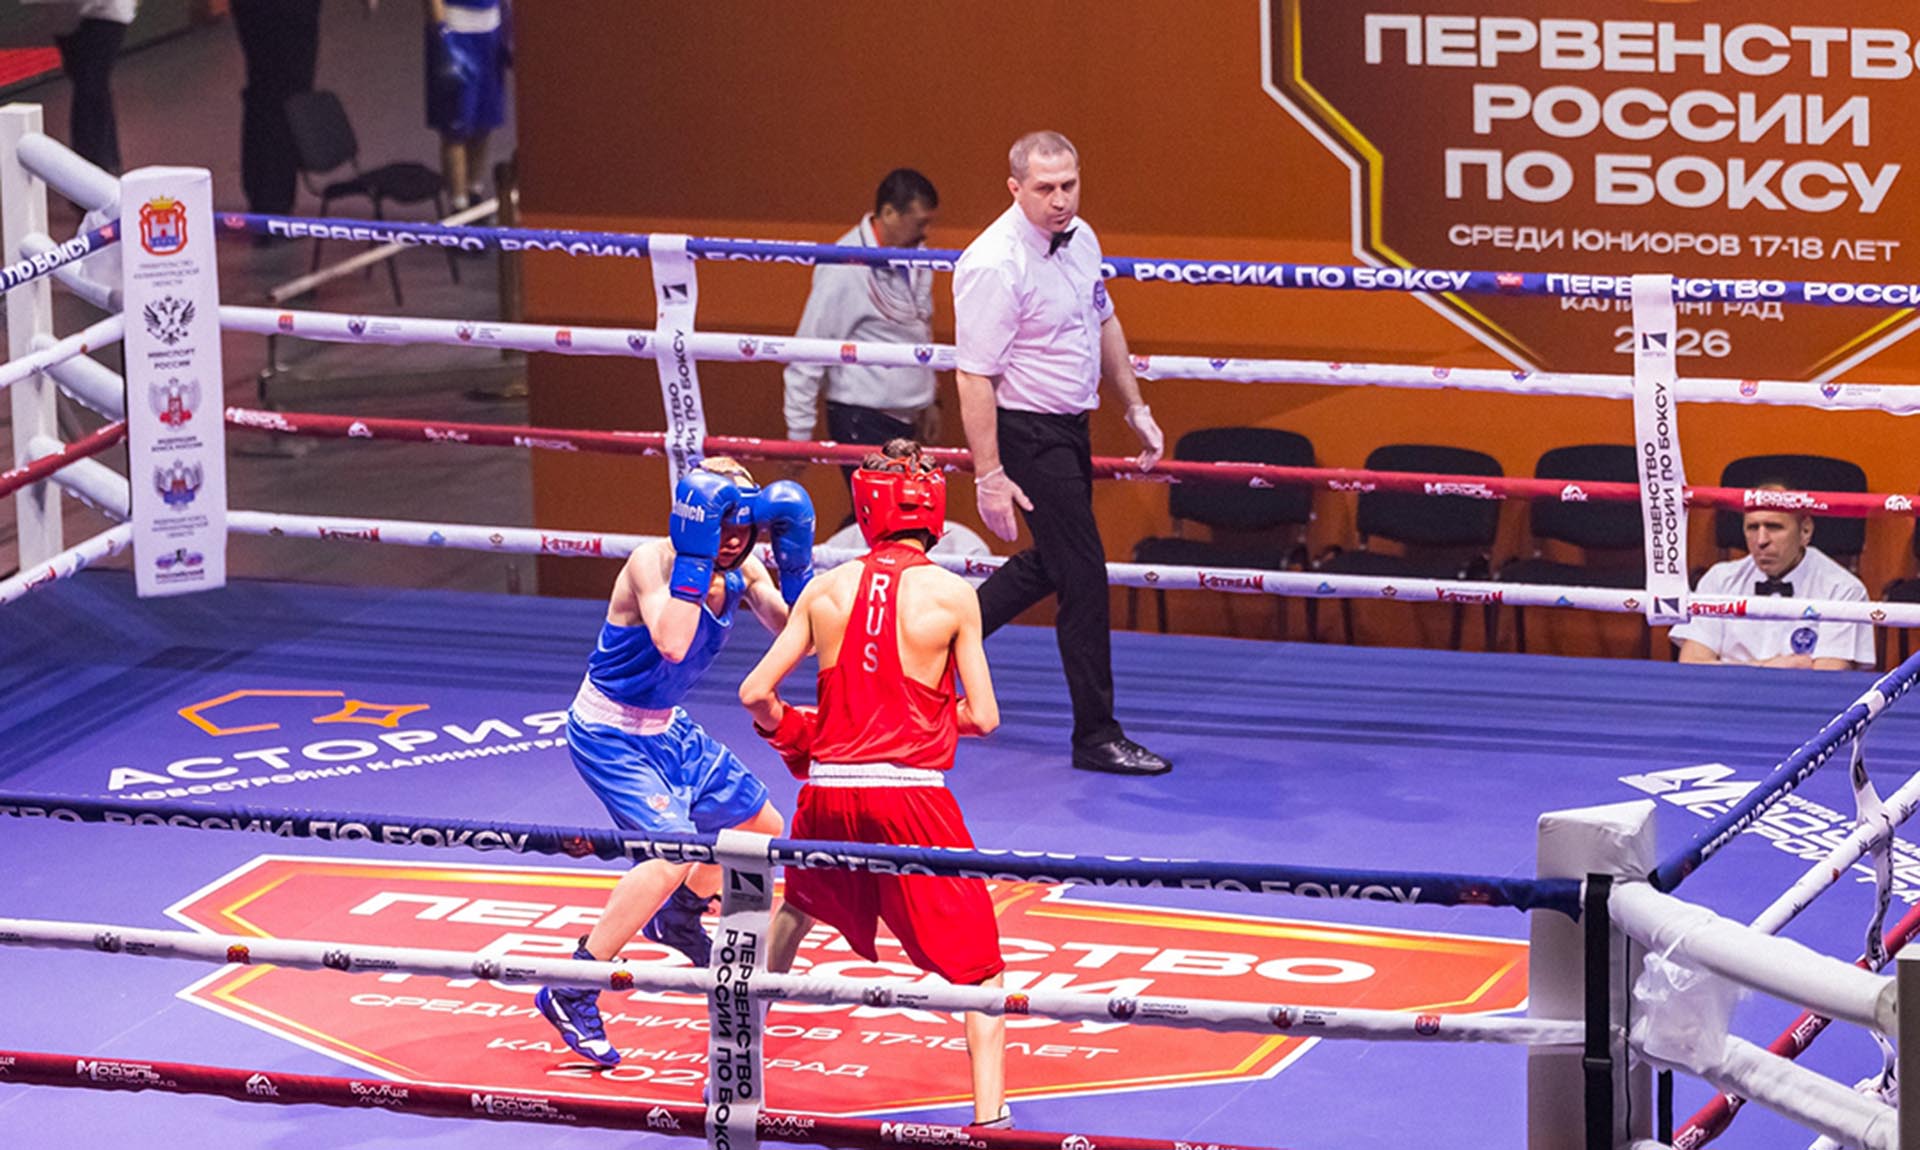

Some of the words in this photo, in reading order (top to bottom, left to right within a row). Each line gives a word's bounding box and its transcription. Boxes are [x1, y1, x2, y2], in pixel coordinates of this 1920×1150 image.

[1364, 14, 1920, 80] ПЕРВЕНСТВ
[1473, 84, 1870, 147] РОССИИ
[1445, 149, 1574, 202] ПО
[1594, 154, 1901, 213] БОКСУ
[1448, 224, 1564, 252] СРЕДИ
[1571, 226, 1741, 258] ЮНИОРОВ
[1748, 236, 1824, 261] 17-18
[1830, 239, 1900, 262] ЛЕТ
[1133, 263, 1284, 287] РОССИИ
[1295, 267, 1346, 288] ПО
[1353, 268, 1472, 291] БОКСУ
[1546, 273, 1787, 299] ПЕРВНСТВО
[1614, 325, 1732, 359] 226
[1655, 382, 1672, 449] БОКСУ
[1660, 454, 1674, 481] ПО
[1644, 442, 1665, 574] ПЕРВЕНСТВО
[1664, 488, 1681, 574] РОССИИ
[862, 573, 891, 673] RUS
[1688, 600, 1748, 616] -STREAM
[107, 711, 570, 791] АСТОРИЯ
[366, 737, 568, 772] КАЛИНИНГРА
[350, 993, 547, 1020] СРЕДИ
[714, 928, 739, 1038] РОССИИ
[733, 931, 758, 1100] ПЕРВЕНСТВО
[545, 1061, 710, 1087] 202
[715, 1046, 733, 1082] ПО
